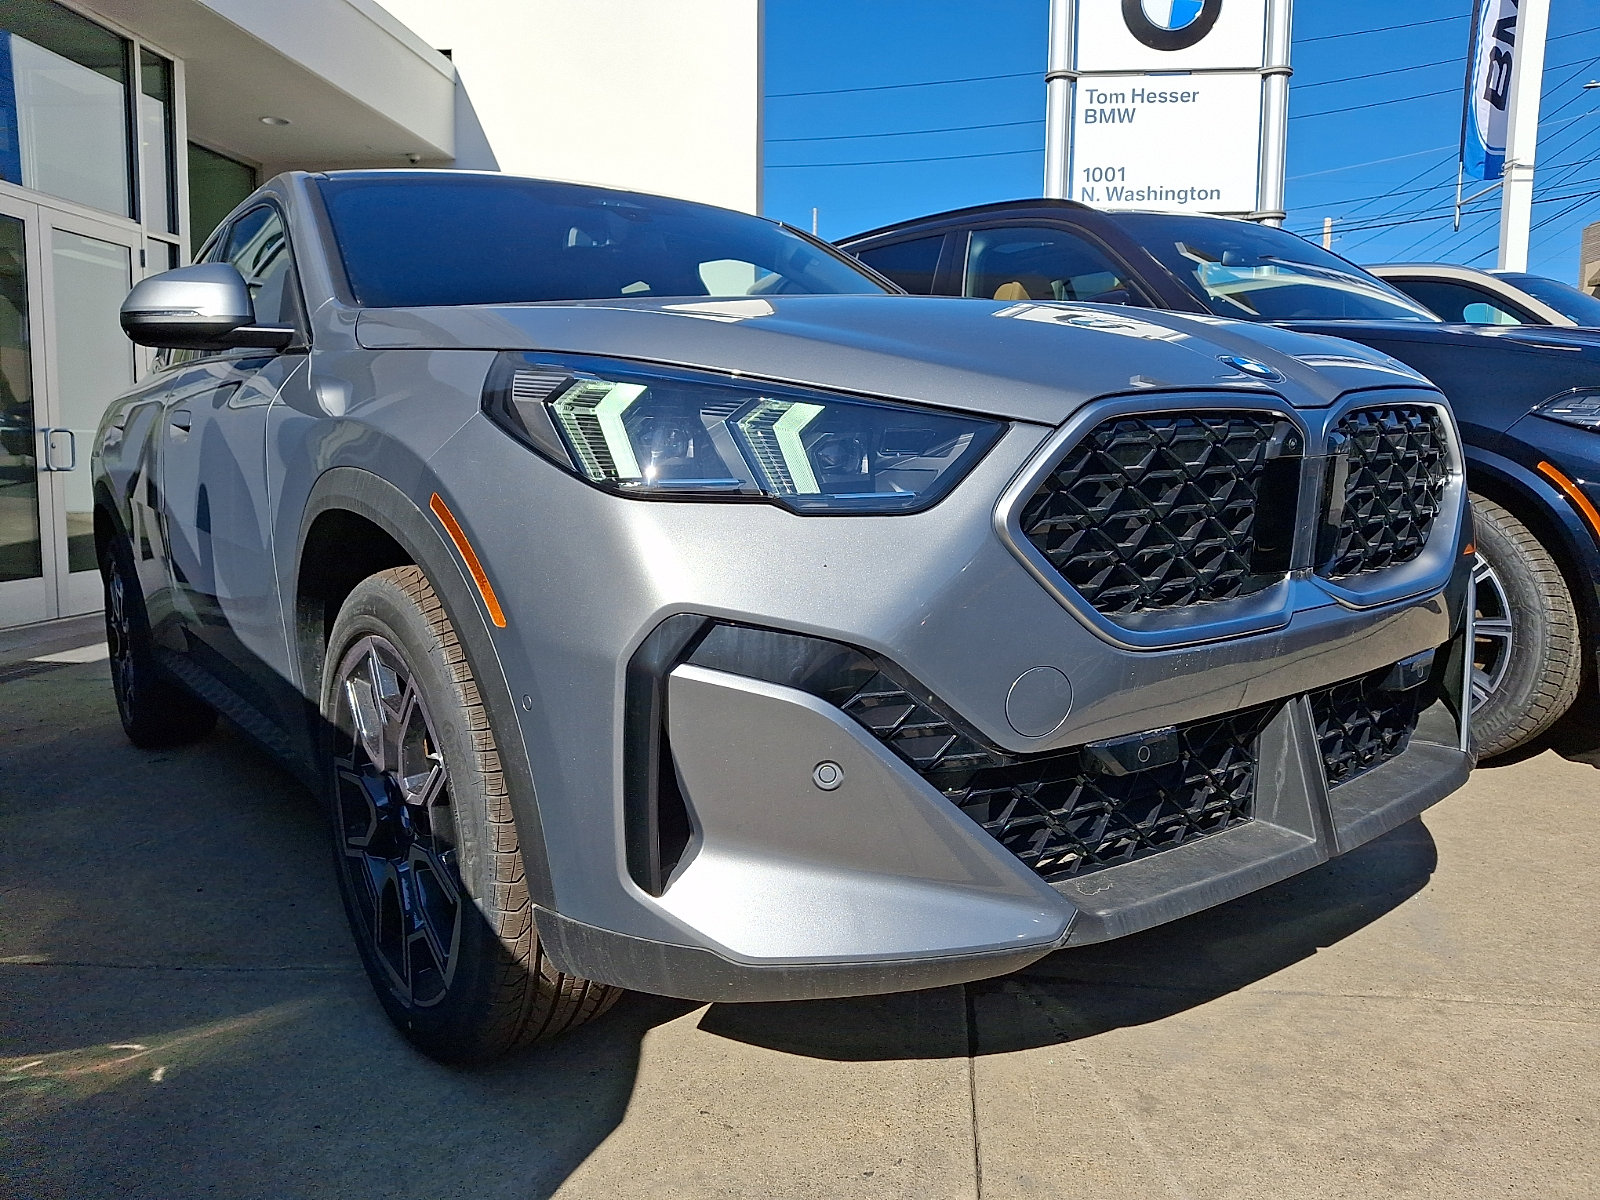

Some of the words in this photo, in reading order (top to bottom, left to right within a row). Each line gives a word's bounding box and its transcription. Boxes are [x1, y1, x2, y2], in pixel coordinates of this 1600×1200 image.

[1085, 88, 1125, 104] Tom
[1131, 88, 1199, 103] Hesser
[1084, 108, 1136, 124] BMW
[1083, 167, 1125, 182] 1001
[1081, 187, 1100, 202] N.
[1106, 186, 1220, 204] Washington
